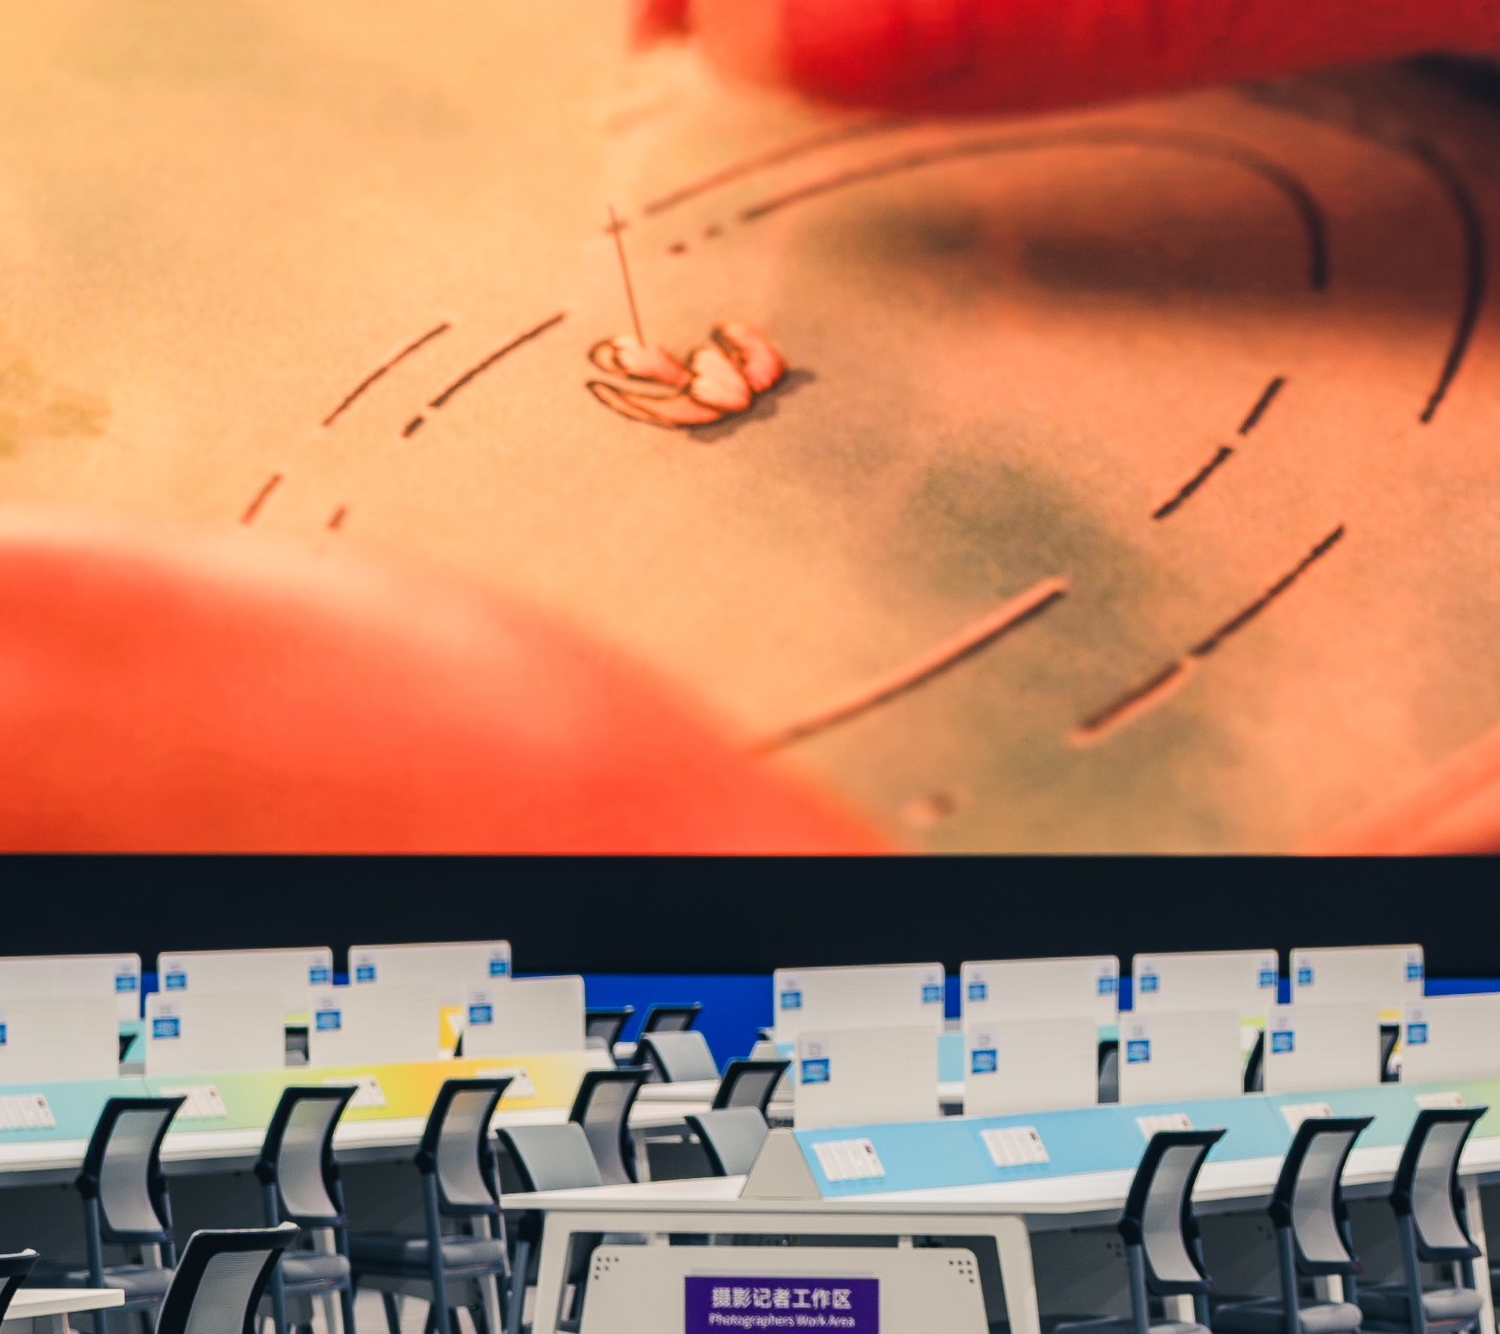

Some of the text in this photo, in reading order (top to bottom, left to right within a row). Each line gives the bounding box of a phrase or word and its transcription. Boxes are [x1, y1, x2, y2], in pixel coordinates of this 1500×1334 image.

[711, 1286, 852, 1310] 摄影记者工作区
[708, 1312, 856, 1329] Photographers Work Area
